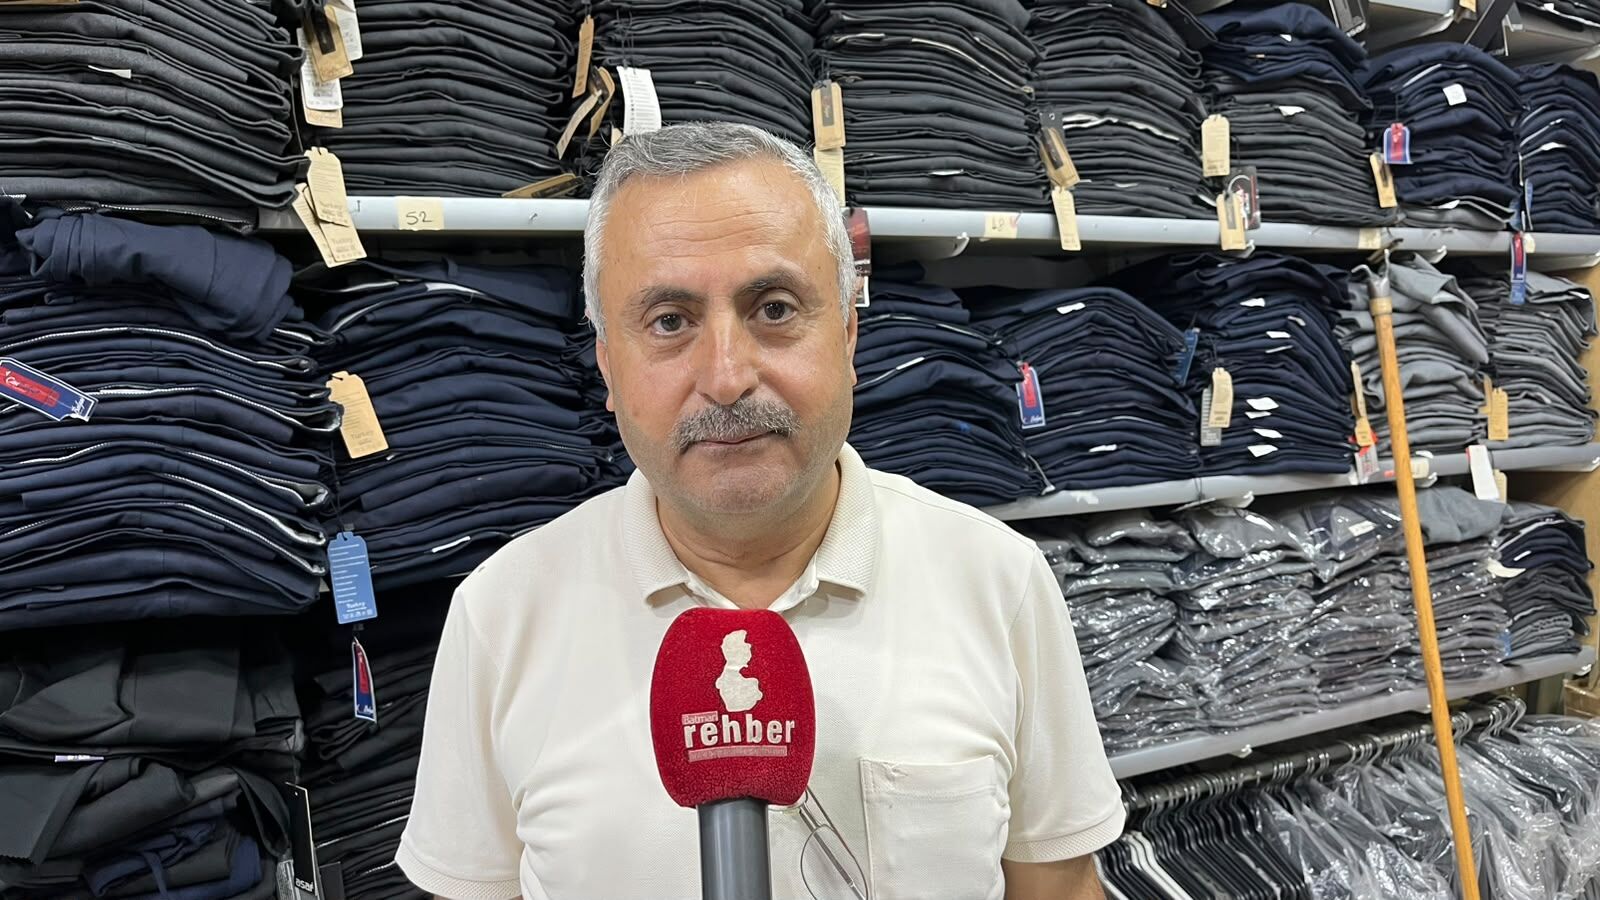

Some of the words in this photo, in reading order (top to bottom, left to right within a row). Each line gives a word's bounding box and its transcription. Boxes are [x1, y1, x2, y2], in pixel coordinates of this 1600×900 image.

[406, 211, 432, 225] 52
[684, 711, 718, 725] Batman
[684, 714, 795, 748] rehber
